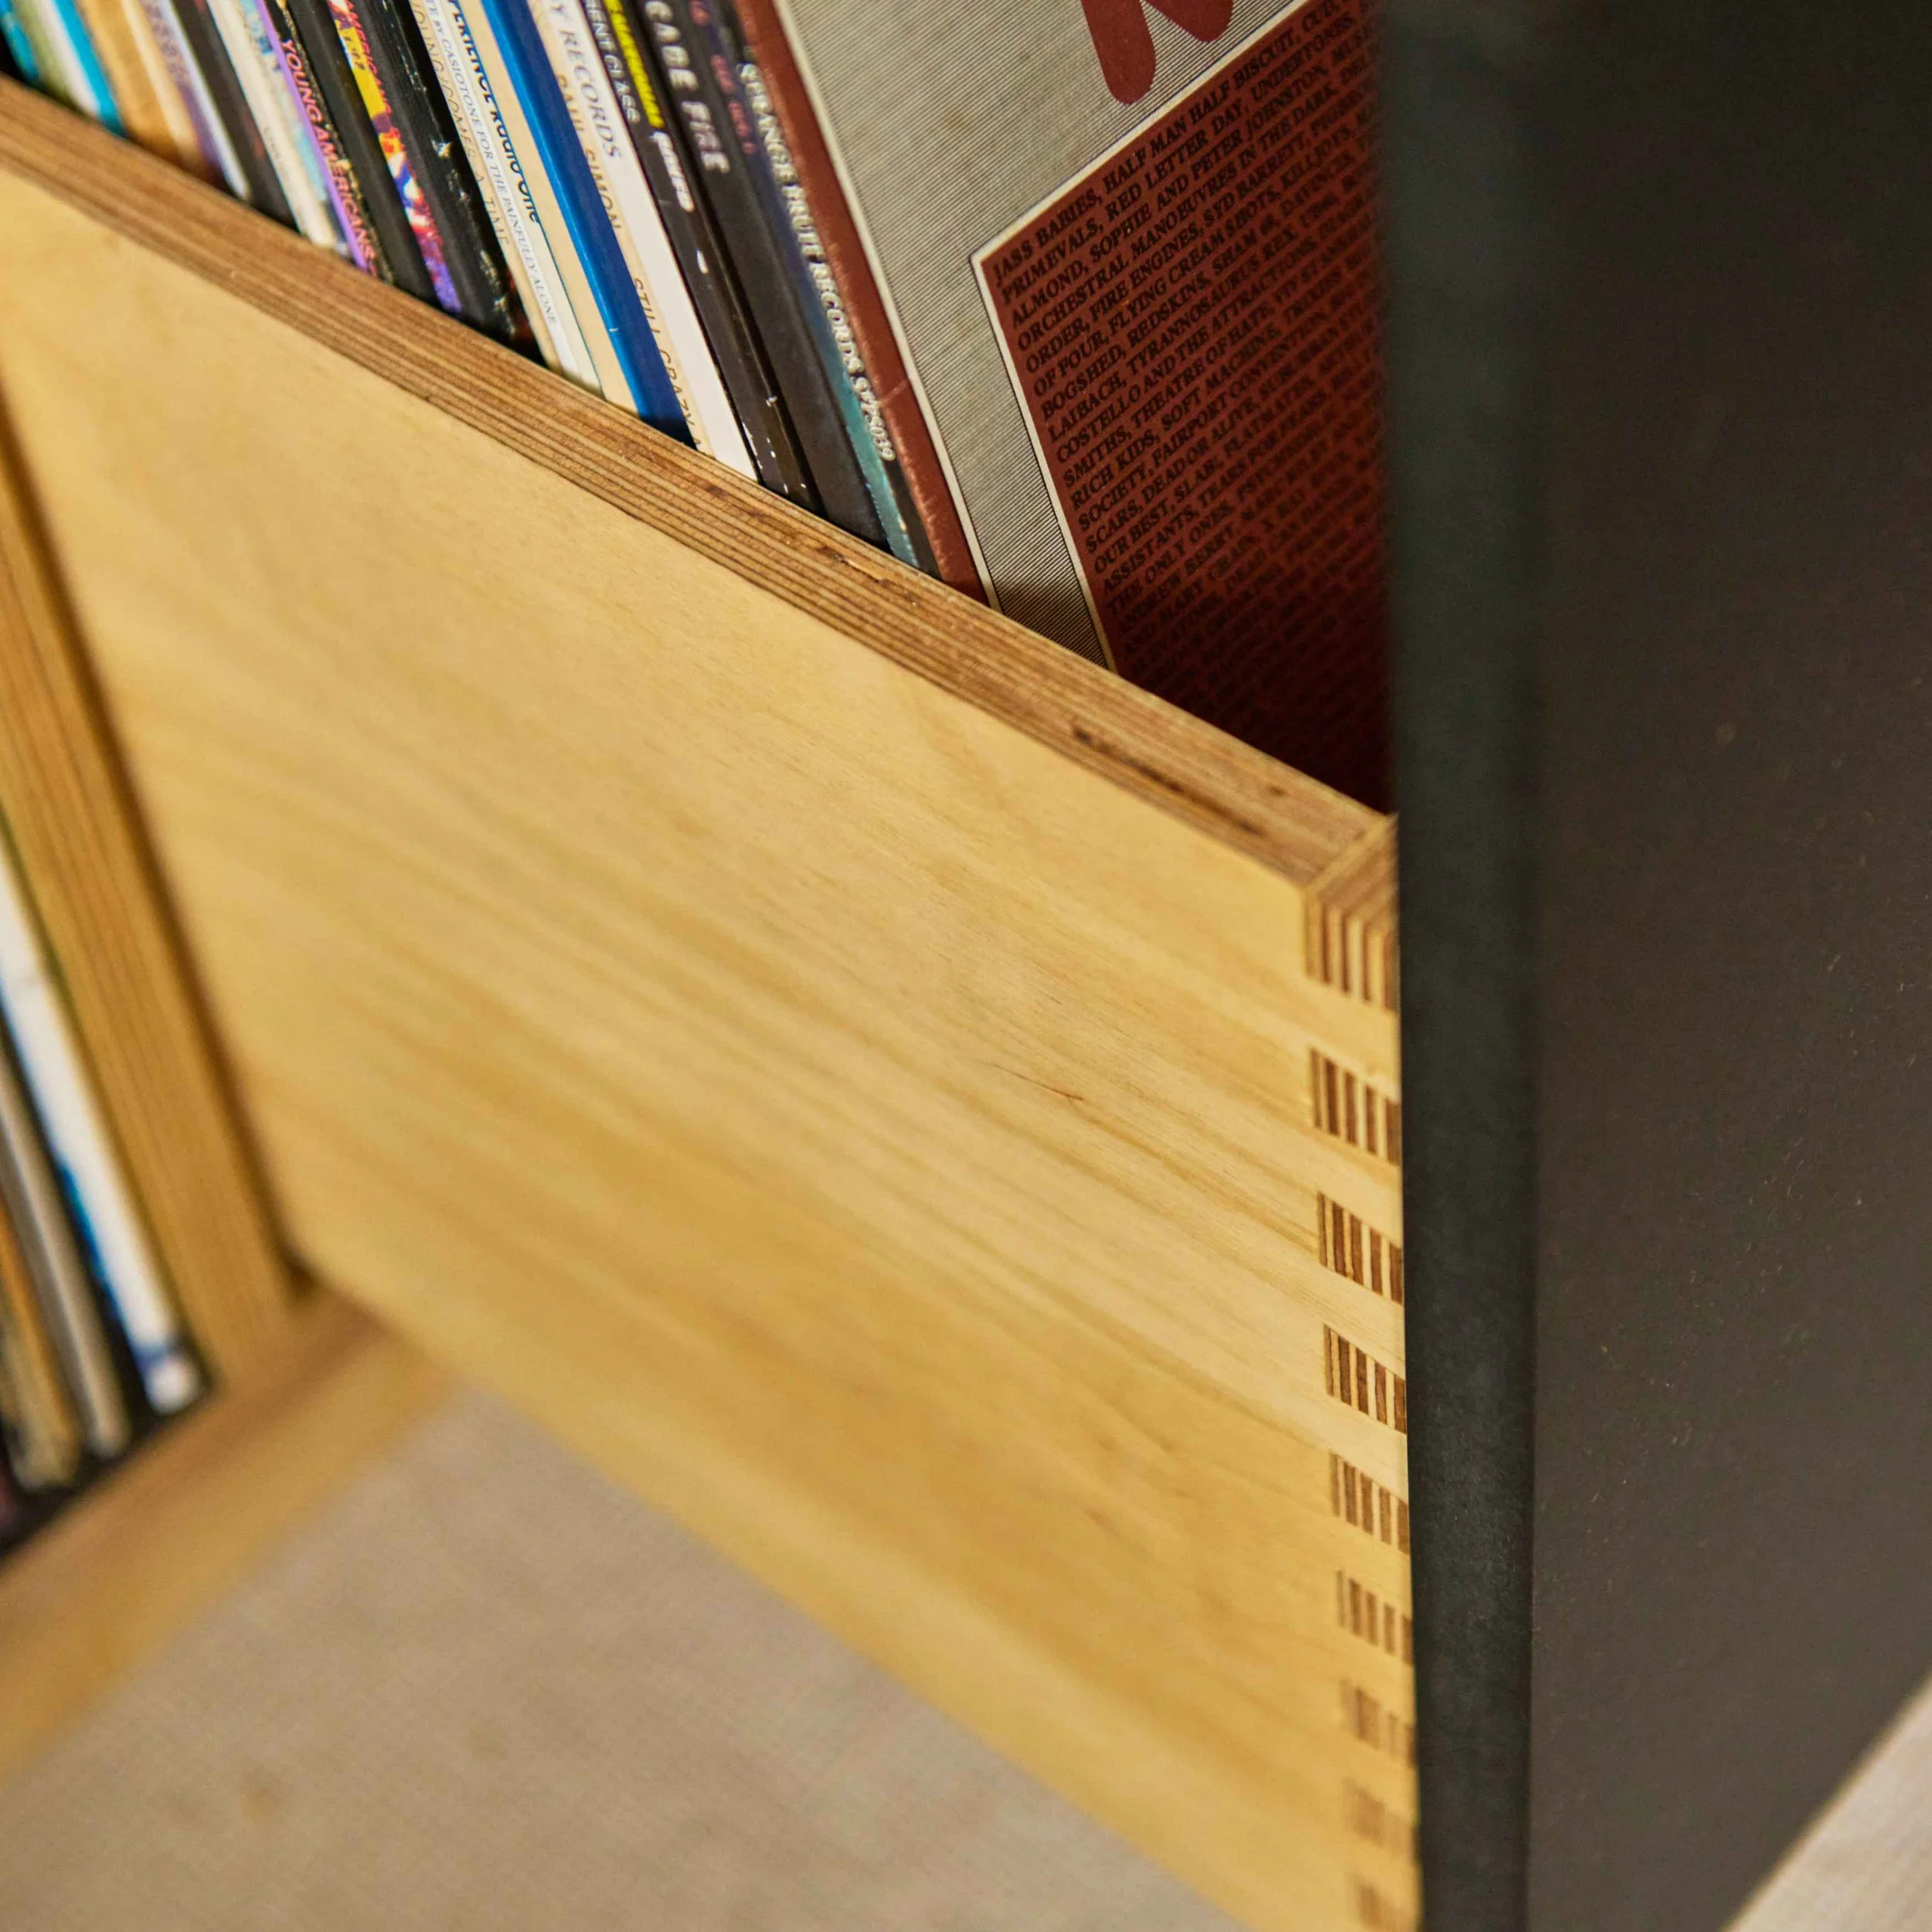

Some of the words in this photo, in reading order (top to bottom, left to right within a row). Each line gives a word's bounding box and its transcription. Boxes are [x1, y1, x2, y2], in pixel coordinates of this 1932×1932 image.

[278, 37, 325, 125] YOUNG
[556, 26, 624, 162] RECORDS
[679, 94, 733, 180] FIRE
[990, 236, 1036, 287] JASS
[1033, 184, 1101, 250] BABIES,
[1101, 145, 1150, 195] HALF
[1148, 114, 1188, 158] MAN
[1187, 77, 1233, 125] HALF
[1230, 22, 1301, 92] BISCUIT,
[439, 36, 484, 128] CASIOTONE
[474, 128, 495, 161] FOR
[488, 163, 508, 196] THE
[499, 196, 539, 276] PAINFULLY
[529, 274, 558, 326] ALONE
[999, 211, 1104, 308] PRIMEVALS,
[1103, 179, 1145, 223] RED
[1142, 126, 1209, 191] LETTER
[1209, 93, 1250, 139] DAY,
[1008, 253, 1089, 332] ALMOND,
[1087, 200, 1153, 266] SOPHIE
[1152, 169, 1191, 213] AND
[1189, 126, 1243, 182] PETER
[1015, 249, 1129, 354] ORCHESTRAL
[1128, 159, 1239, 260] MANOEUVRES
[1236, 142, 1258, 171] IN
[1257, 114, 1293, 154] THE
[803, 256, 870, 376] RECORDS
[1022, 310, 1090, 378] ORDER,
[1087, 278, 1129, 323] FIRE
[1128, 216, 1205, 291] ENGINES,
[1201, 189, 1236, 229] SYD
[1031, 366, 1059, 400] OF
[1056, 324, 1110, 379] FOUR,
[1107, 274, 1168, 337] FLYING
[1165, 226, 1226, 287] CREAM
[1223, 180, 1281, 240] SHOTS,
[1039, 338, 1127, 423] BOGSHED,
[1125, 267, 1212, 349] REDSKINS,
[1210, 226, 1258, 277] SHAM
[1046, 367, 1127, 446] LAIBACH,
[1124, 253, 1262, 379] TYRANNOSAURUS
[1054, 381, 1143, 467] COSTELLO
[1140, 351, 1179, 393] AND
[1174, 323, 1210, 365] THE
[1062, 420, 1131, 491] SMITHS,
[1129, 355, 1206, 431] THEATRE
[1203, 334, 1230, 368] OF
[1070, 462, 1114, 511] RICH
[1114, 423, 1160, 474] KIDS,
[1159, 385, 1204, 434] SOFT
[1077, 457, 1154, 534] SOCIETY,
[1151, 391, 1229, 468] FAIRPORT
[1083, 493, 1143, 556] SCARS,
[1140, 454, 1187, 505] DEAD
[1184, 434, 1209, 468] OR
[1092, 533, 1130, 577] OUR
[1128, 493, 1176, 546] BEST,
[1141, 536, 1187, 587] ONLY
